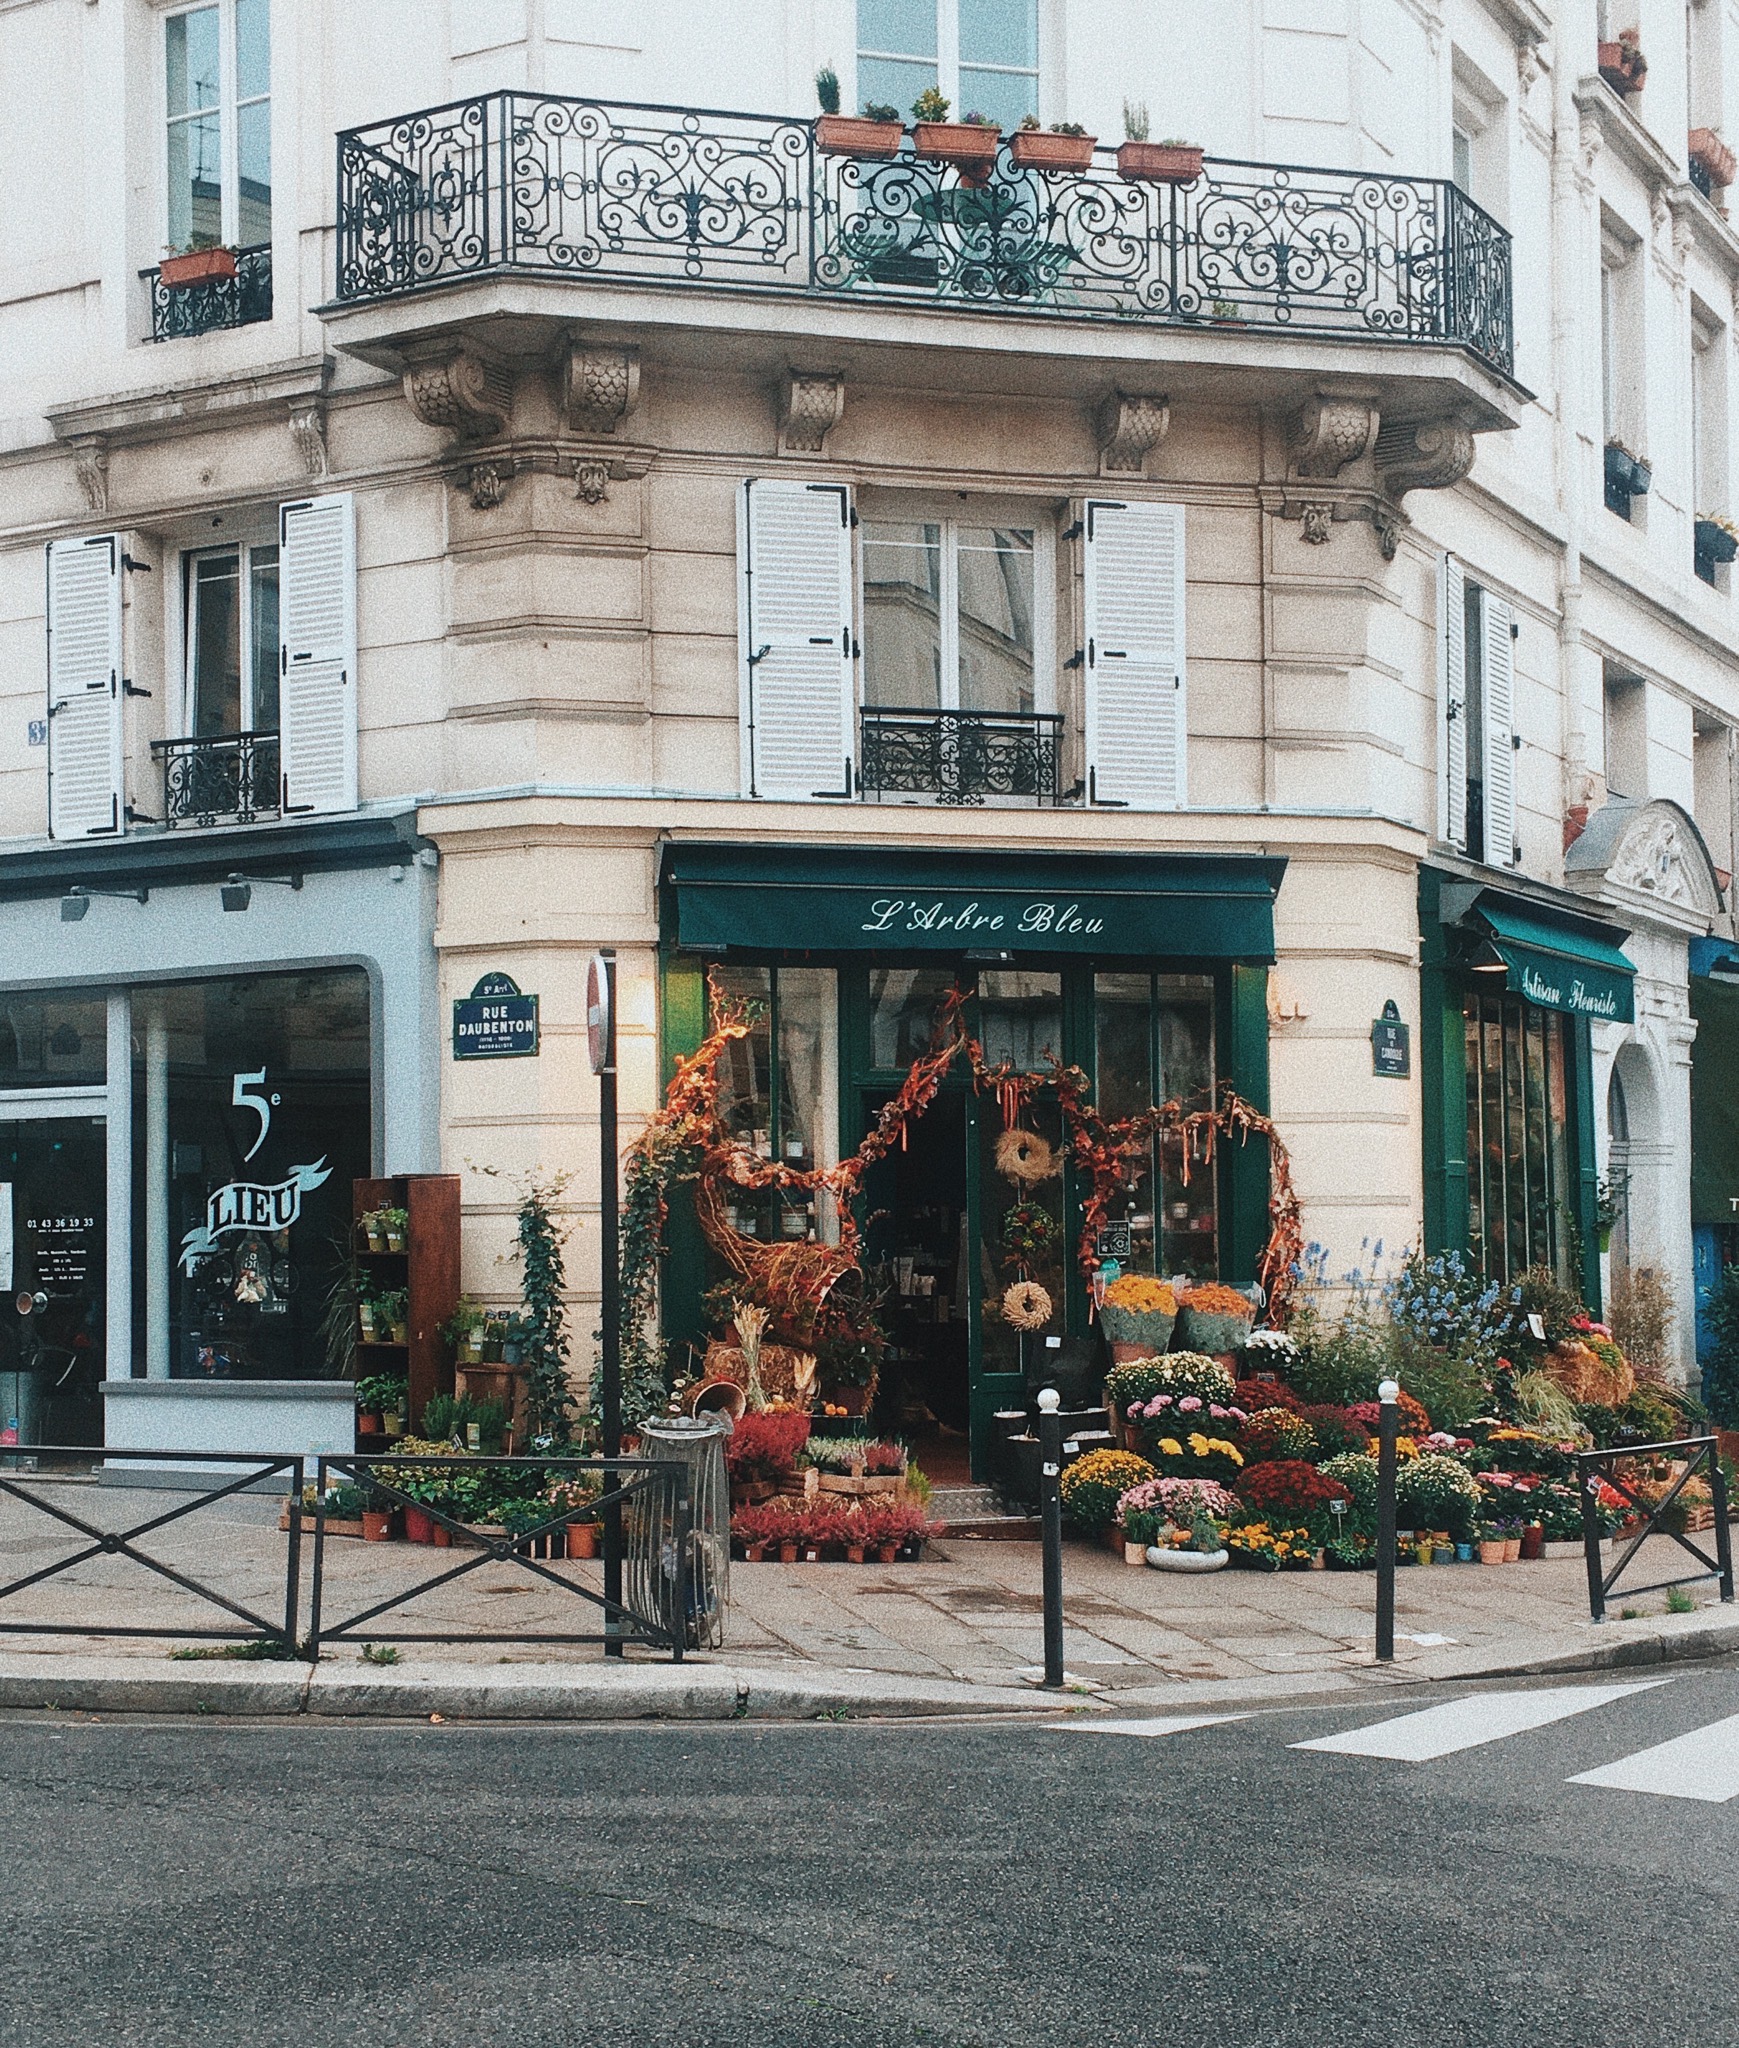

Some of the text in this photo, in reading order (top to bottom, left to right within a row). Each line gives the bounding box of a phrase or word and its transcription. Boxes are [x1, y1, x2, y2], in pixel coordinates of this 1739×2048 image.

[861, 899, 1104, 934] L'Arbre Bleu
[1522, 966, 1617, 1015] Artisan Fleuriste
[482, 1005, 508, 1019] RUE
[459, 1020, 534, 1036] DAUBENTON
[209, 1180, 299, 1235] LIEU
[27, 1217, 94, 1228] 01 43 36 19 33
